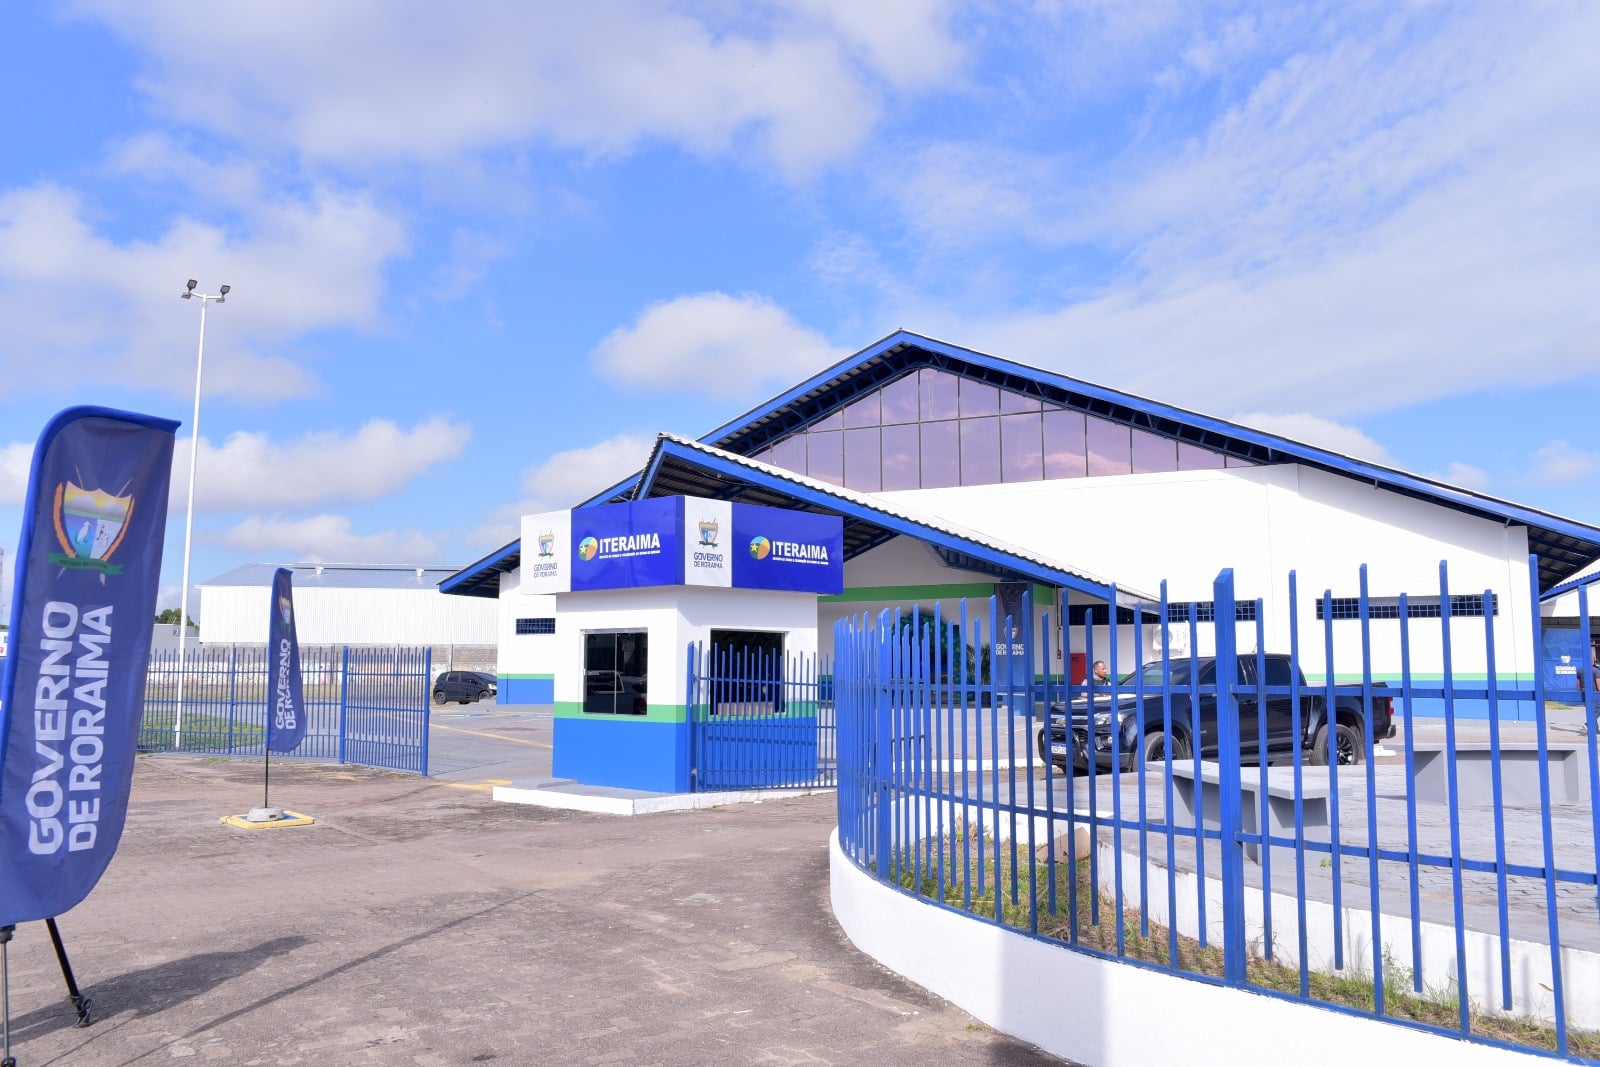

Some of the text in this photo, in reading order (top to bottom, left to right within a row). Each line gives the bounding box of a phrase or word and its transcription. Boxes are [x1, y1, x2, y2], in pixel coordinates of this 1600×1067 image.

[599, 533, 660, 553] ITERAIMA
[772, 541, 829, 560] ITERAIMA
[533, 563, 557, 571] GOVERNO
[694, 552, 723, 562] GOVERNO
[995, 643, 1025, 651] GOVRNO
[275, 638, 289, 730] GOVERNO
[68, 605, 114, 791] RORAIMA
[25, 601, 79, 855] GOVERNO
[284, 710, 296, 730] DE
[68, 798, 101, 852] DE
